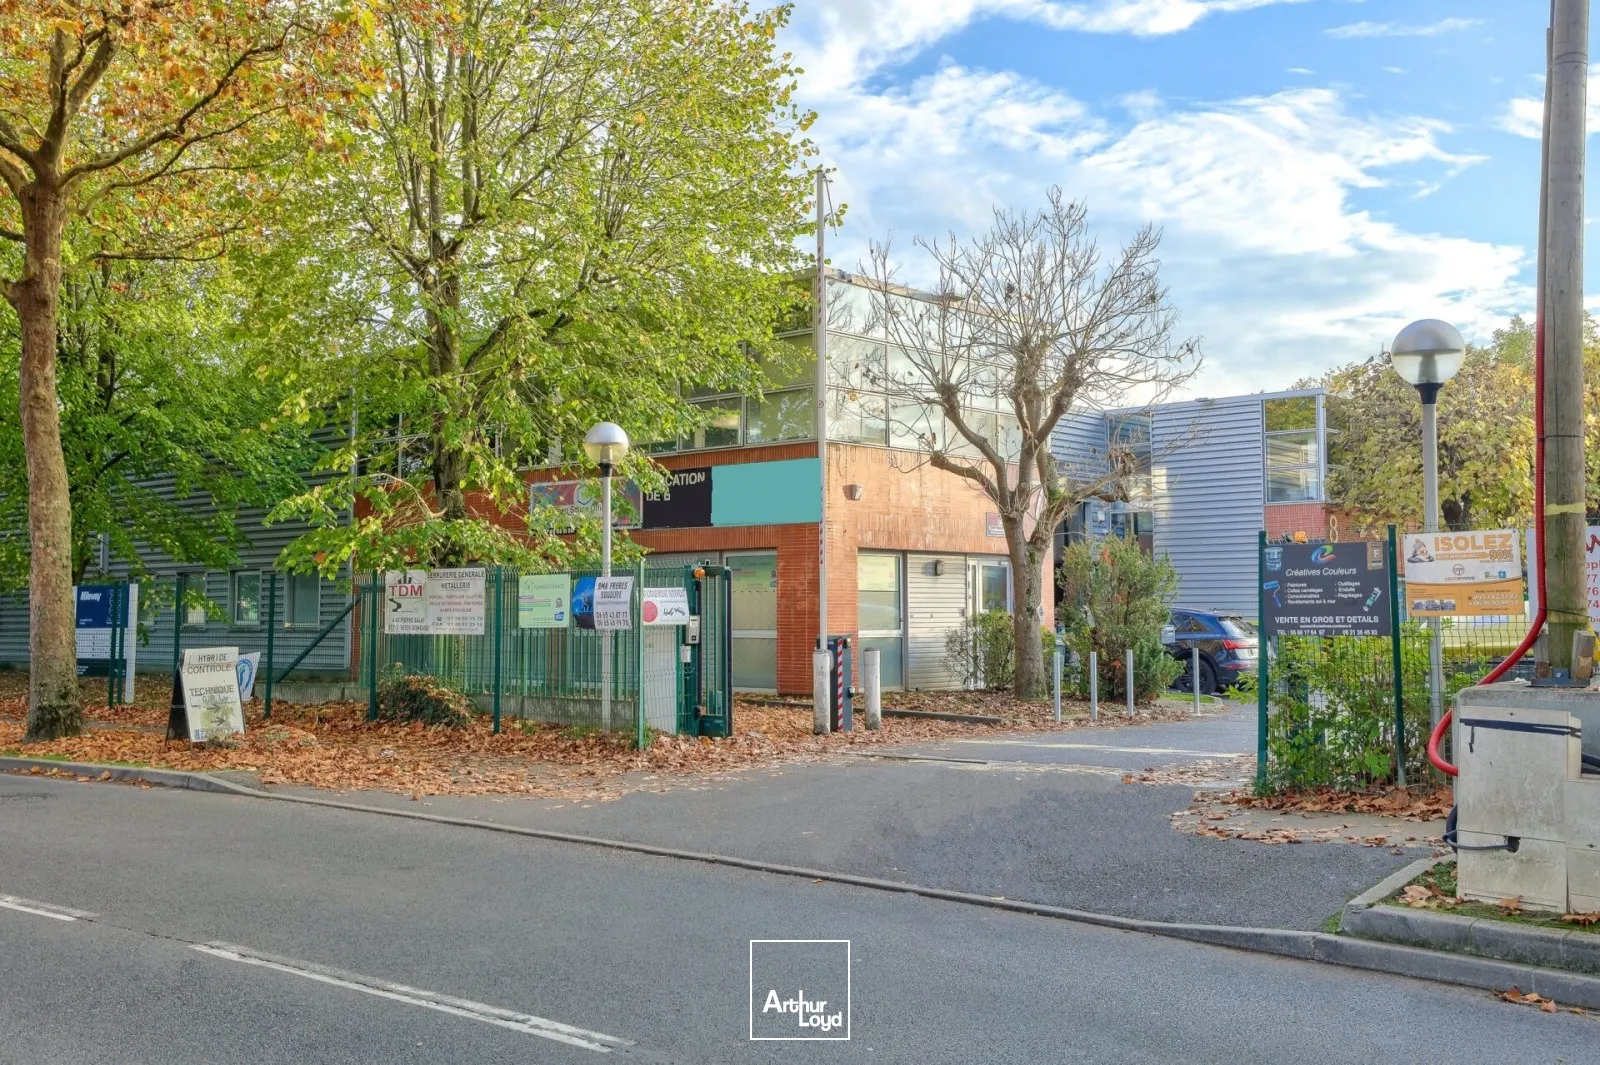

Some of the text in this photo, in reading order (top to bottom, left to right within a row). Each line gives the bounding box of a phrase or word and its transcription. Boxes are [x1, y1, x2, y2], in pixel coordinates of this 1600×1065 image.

[665, 472, 705, 487] CATION
[1330, 515, 1338, 542] 8
[1434, 534, 1513, 552] ISOLEZ
[1286, 567, 1357, 576] Créatives Couleurs
[388, 584, 423, 596] TDM
[609, 582, 628, 590] FRERES
[198, 654, 227, 662] HYBRIDE
[187, 664, 232, 674] CONTROLE
[190, 685, 234, 696] TECHNIQUE
